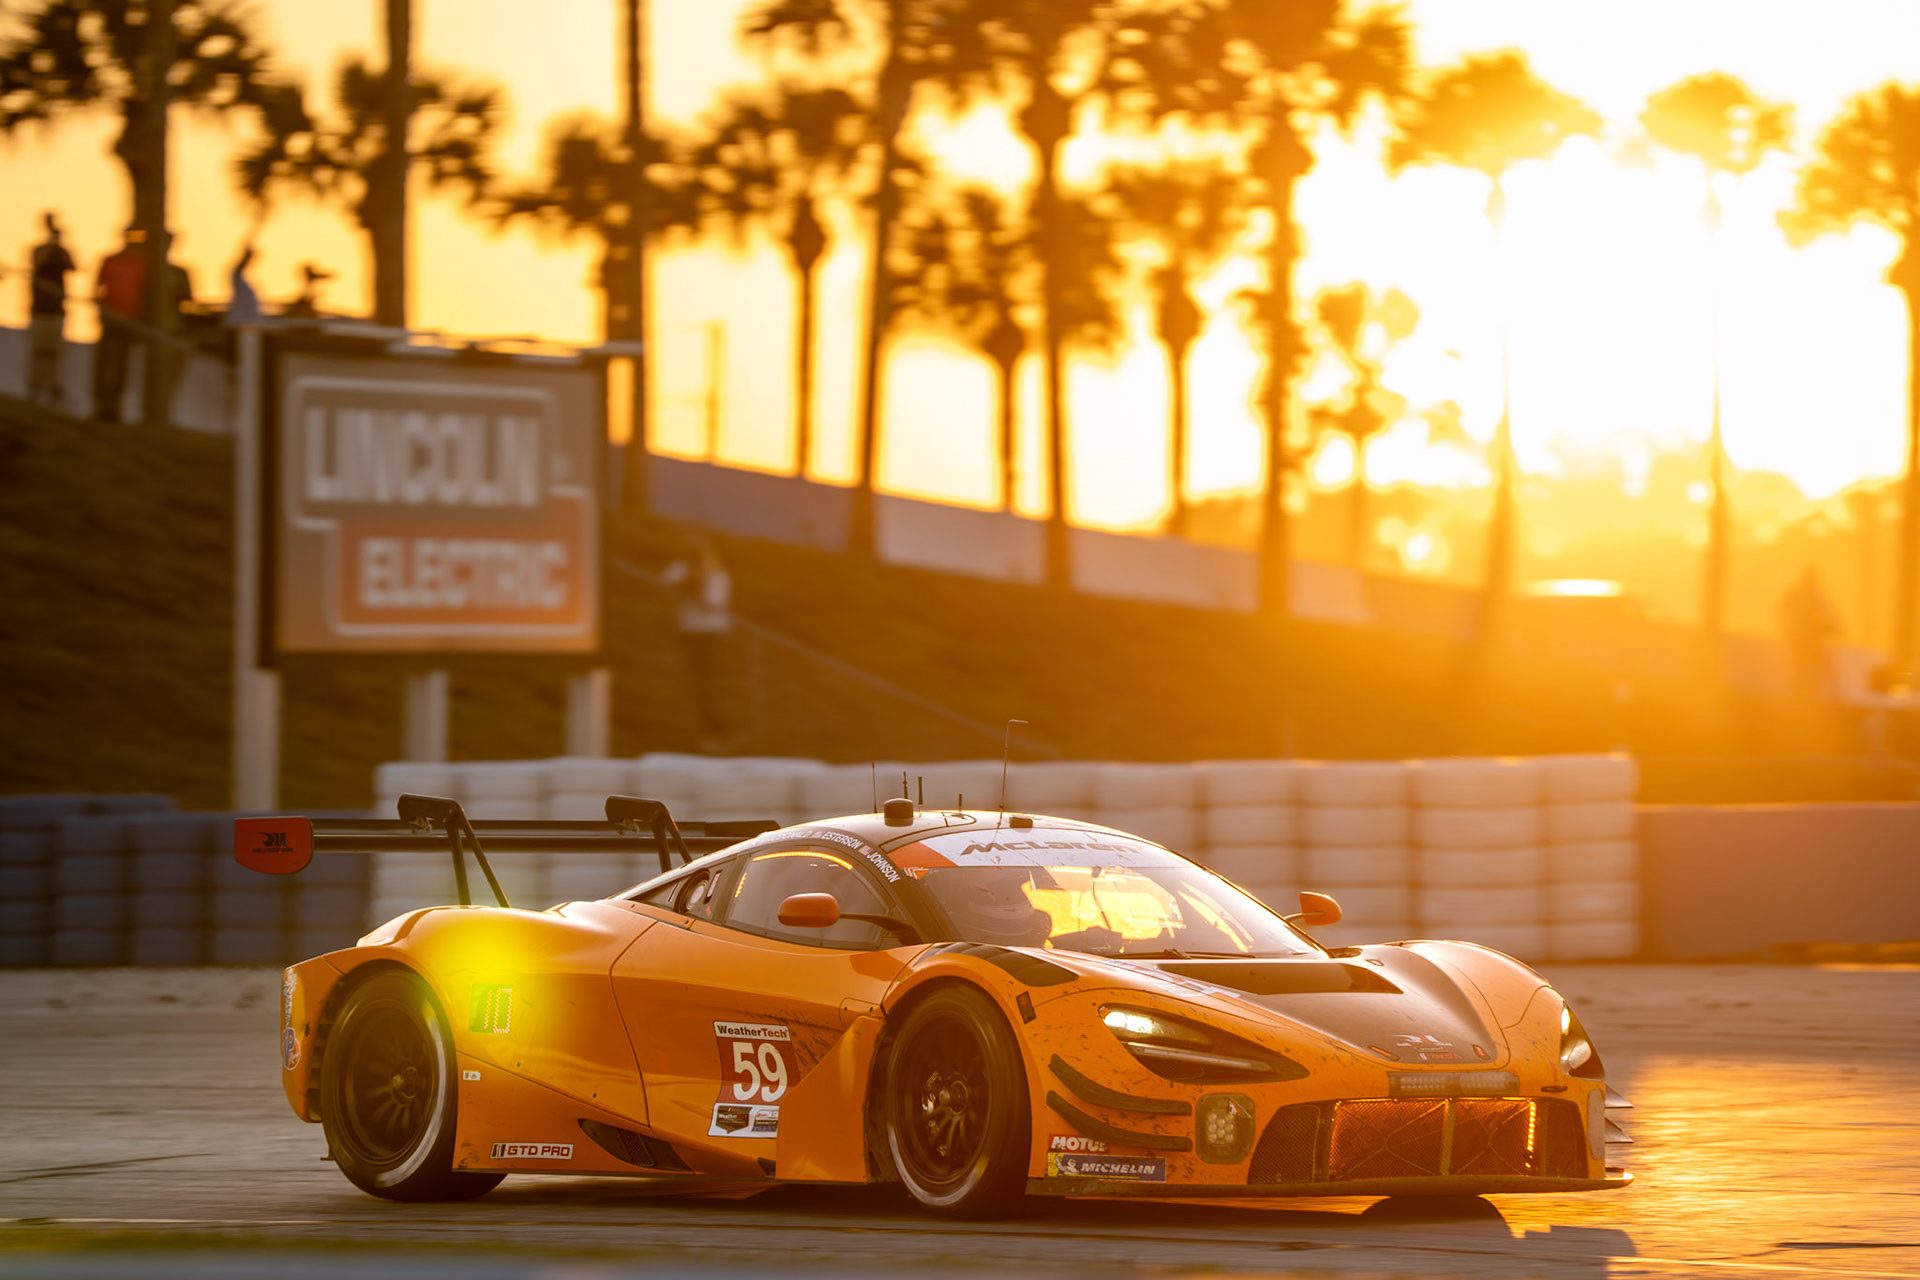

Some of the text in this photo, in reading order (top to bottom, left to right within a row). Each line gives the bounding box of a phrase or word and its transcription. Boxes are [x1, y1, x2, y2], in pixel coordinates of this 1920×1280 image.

[304, 406, 542, 506] LINCOLN
[358, 537, 569, 608] ELECTRIC
[822, 831, 864, 850] ESTERSON
[866, 851, 901, 884] JOHNSON
[960, 841, 1139, 856] McLaren
[717, 1025, 788, 1039] WeatherTech
[732, 1041, 788, 1103] 59
[507, 1145, 571, 1157] GTD PRO
[1081, 1162, 1155, 1174] MICHELIN
